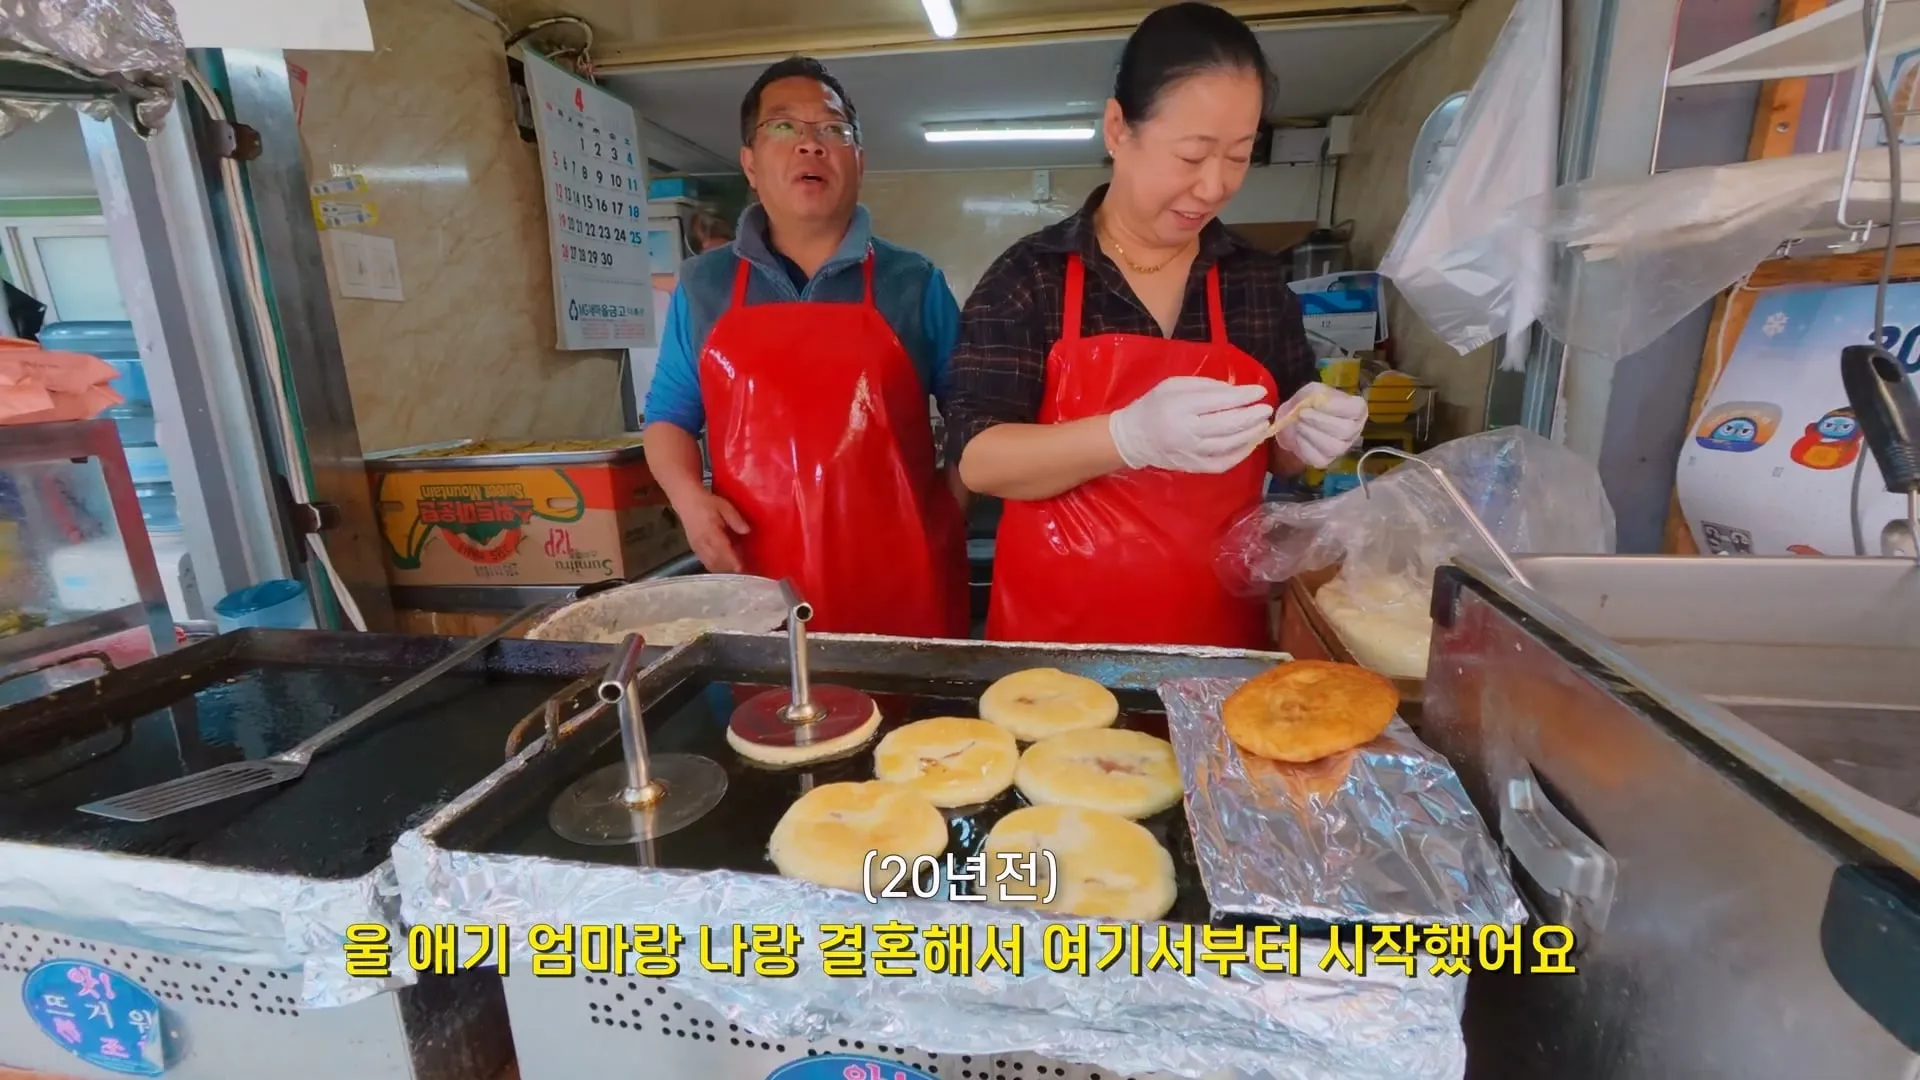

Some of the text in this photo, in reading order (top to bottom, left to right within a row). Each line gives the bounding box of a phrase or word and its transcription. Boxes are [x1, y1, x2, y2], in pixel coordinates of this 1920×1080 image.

[575, 87, 584, 113] 4
[594, 142, 601, 157] 2
[610, 147, 618, 161] 3
[627, 151, 634, 166] 4
[552, 149, 558, 166] 5
[582, 165, 588, 180] 8
[596, 169, 604, 184] 9
[610, 173, 622, 188] 10
[627, 177, 638, 192] 11
[555, 181, 563, 199] 12
[573, 189, 580, 204] 14
[582, 194, 593, 209] 15
[596, 198, 608, 212] 16
[612, 201, 624, 215] 17
[628, 204, 640, 218] 18
[559, 212, 566, 228] 19
[576, 218, 583, 234] 21
[585, 222, 596, 237] 22
[598, 224, 611, 240] 23
[614, 227, 626, 242] 24
[630, 230, 642, 245] 25
[588, 250, 598, 264] 29
[600, 252, 613, 266] 30
[420, 484, 482, 499] Mountain
[554, 558, 613, 577] Sumifru
